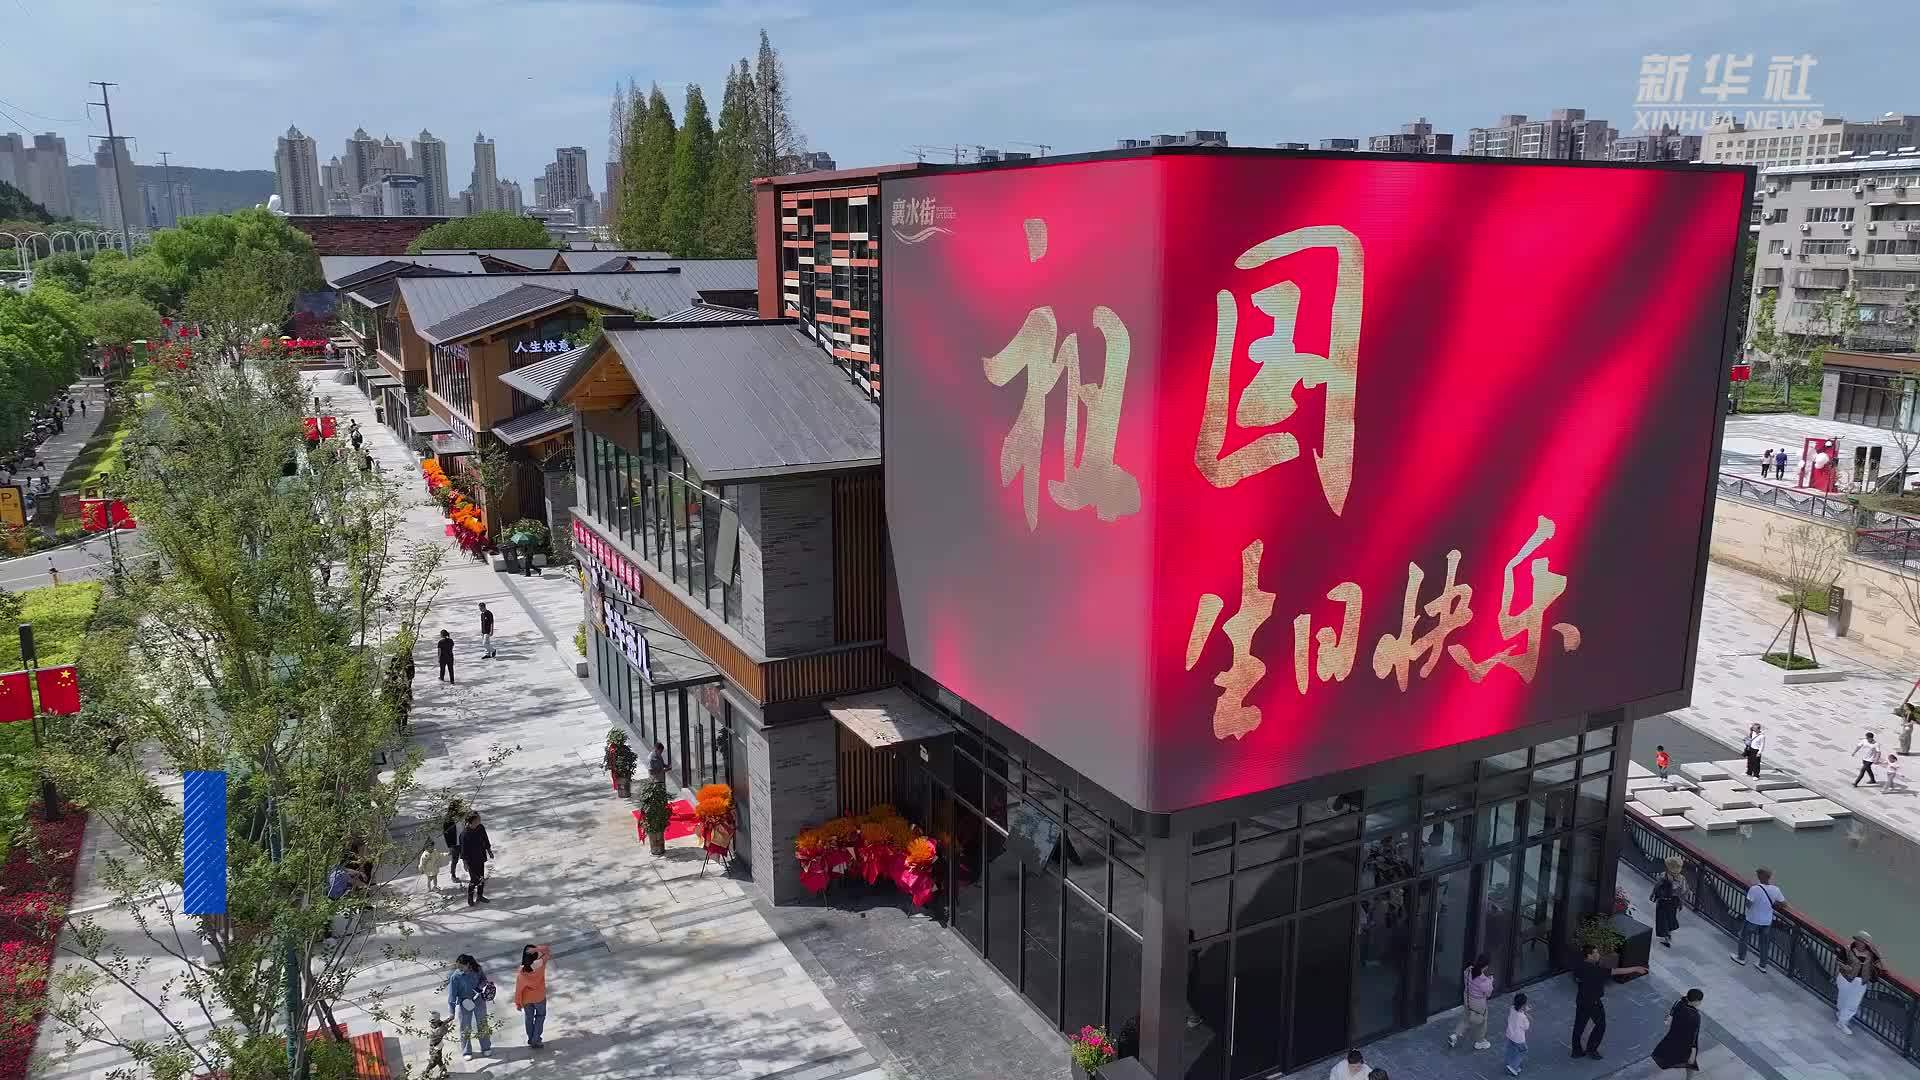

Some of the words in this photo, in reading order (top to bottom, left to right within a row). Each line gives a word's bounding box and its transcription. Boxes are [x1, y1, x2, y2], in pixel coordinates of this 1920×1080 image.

[982, 217, 1365, 532] 祖国
[1186, 514, 1582, 741] 生日快乐
